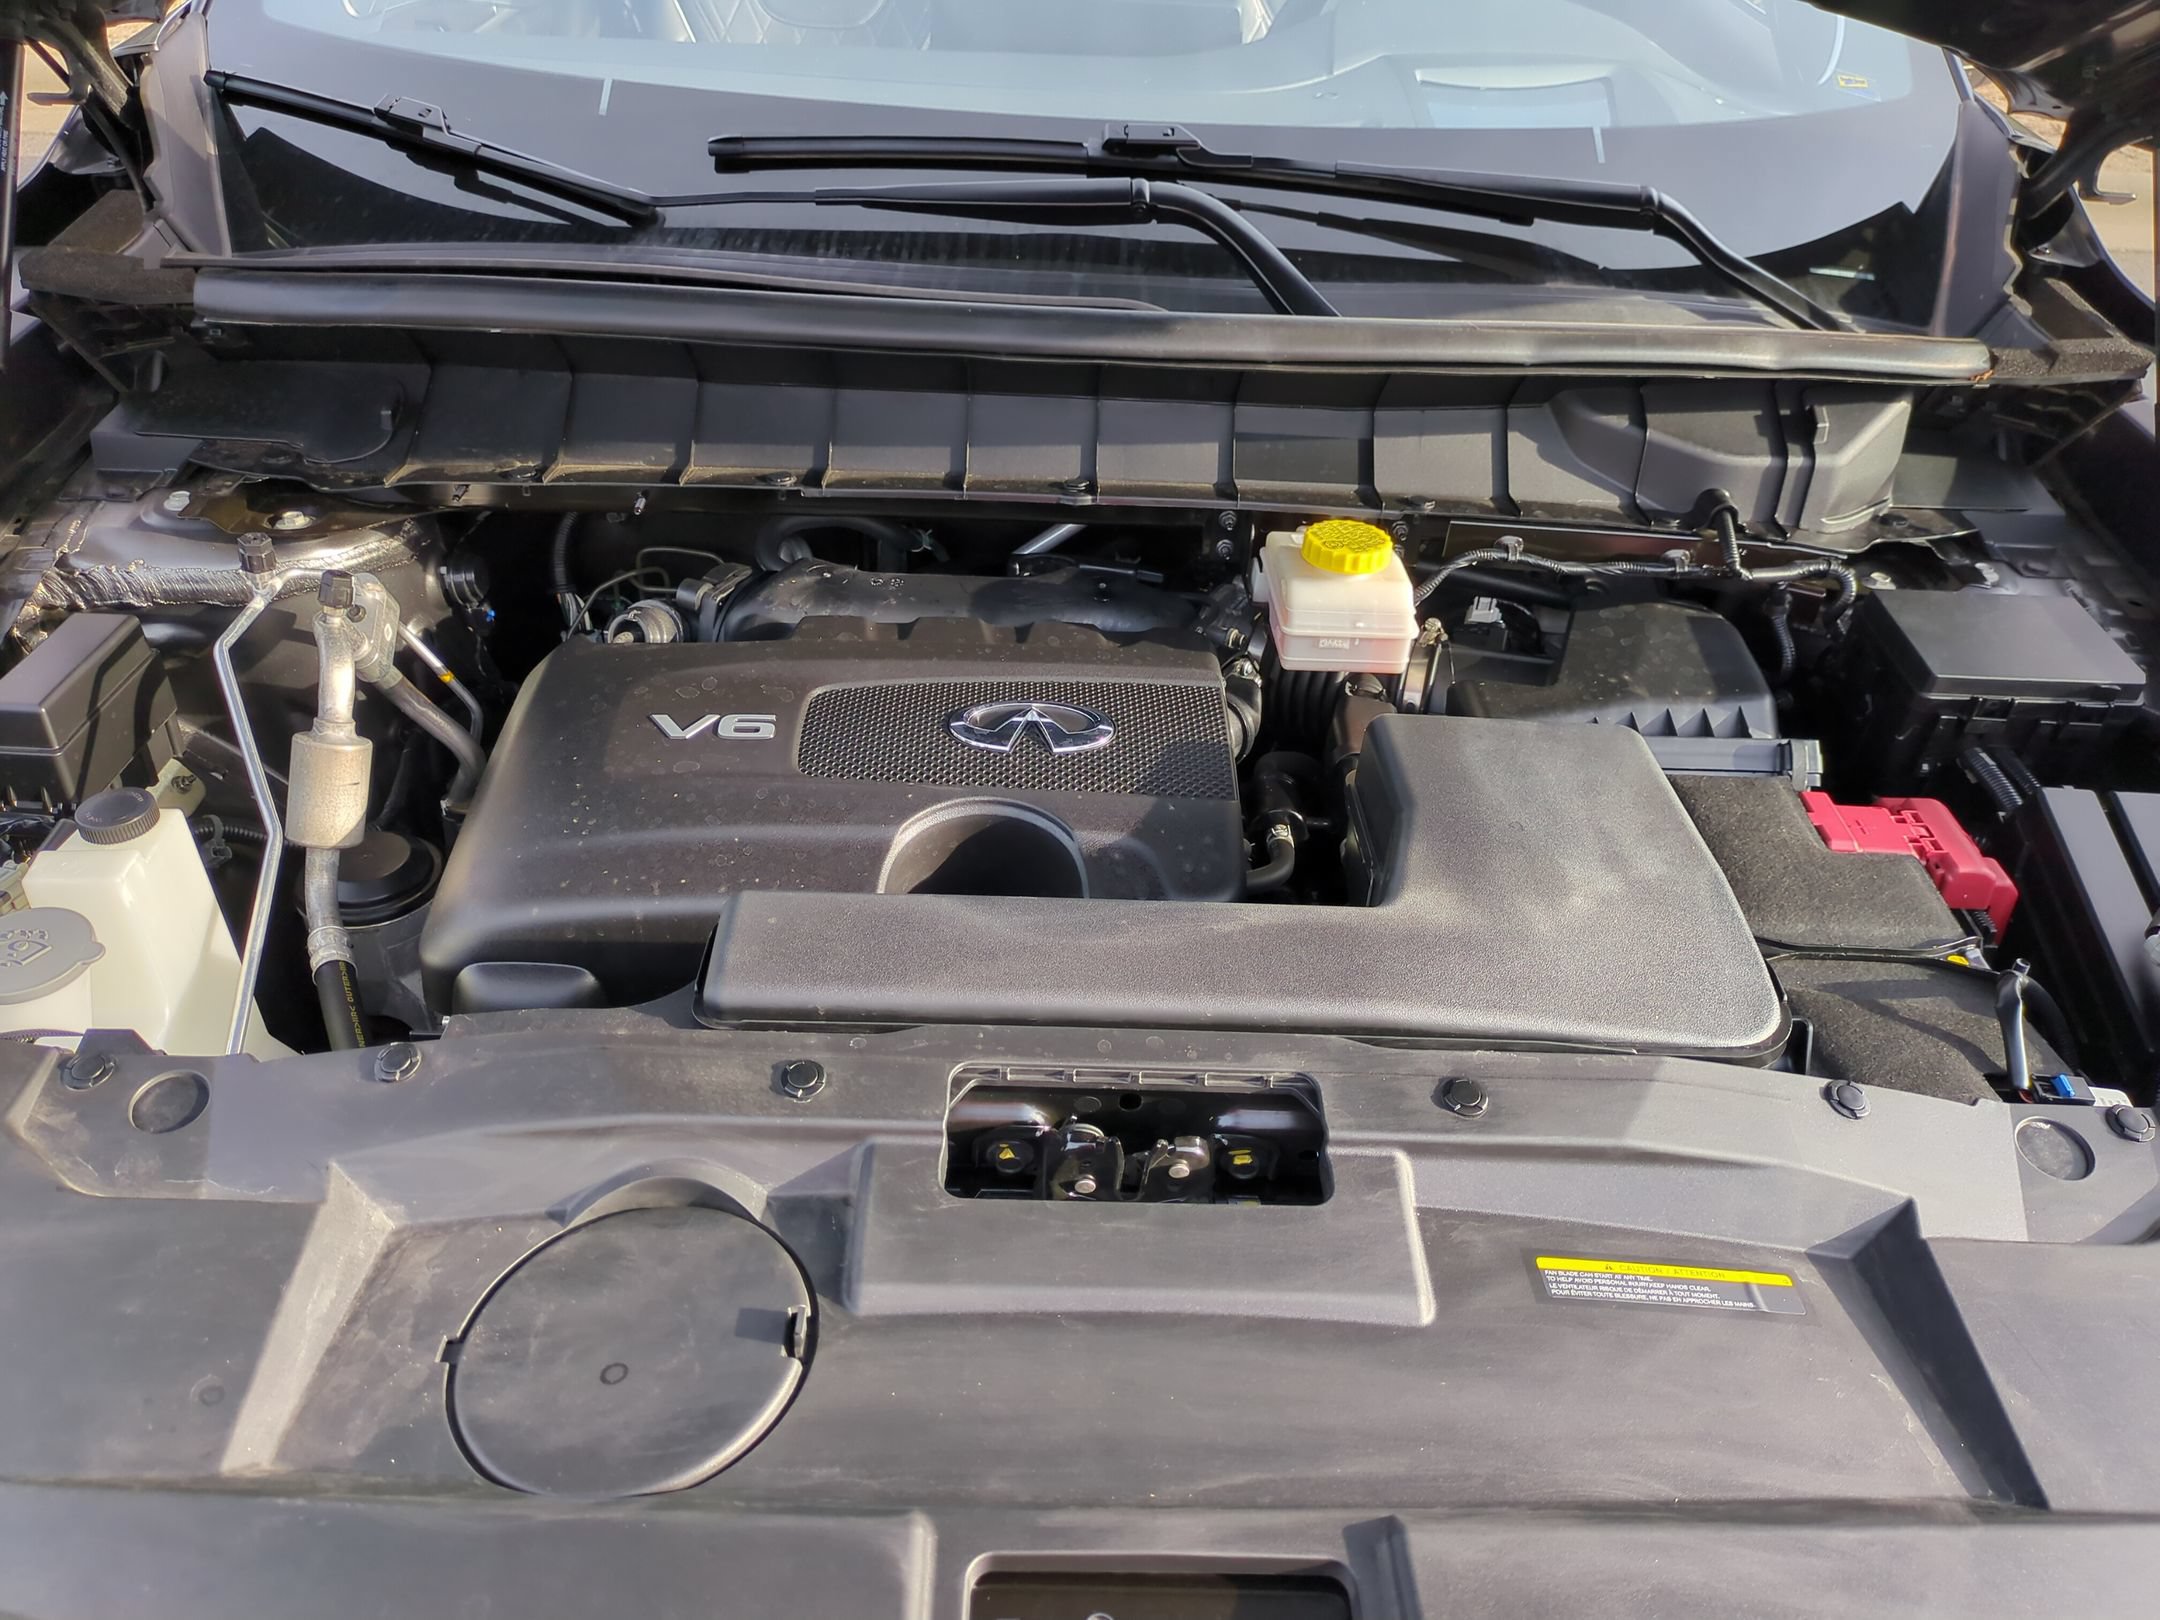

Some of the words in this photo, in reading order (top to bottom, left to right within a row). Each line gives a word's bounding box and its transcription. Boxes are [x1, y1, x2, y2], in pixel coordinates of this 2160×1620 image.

[650, 714, 776, 741] V6
[1619, 1265, 1663, 1274] CAUTION
[1674, 1269, 1725, 1278] ATTENTION
